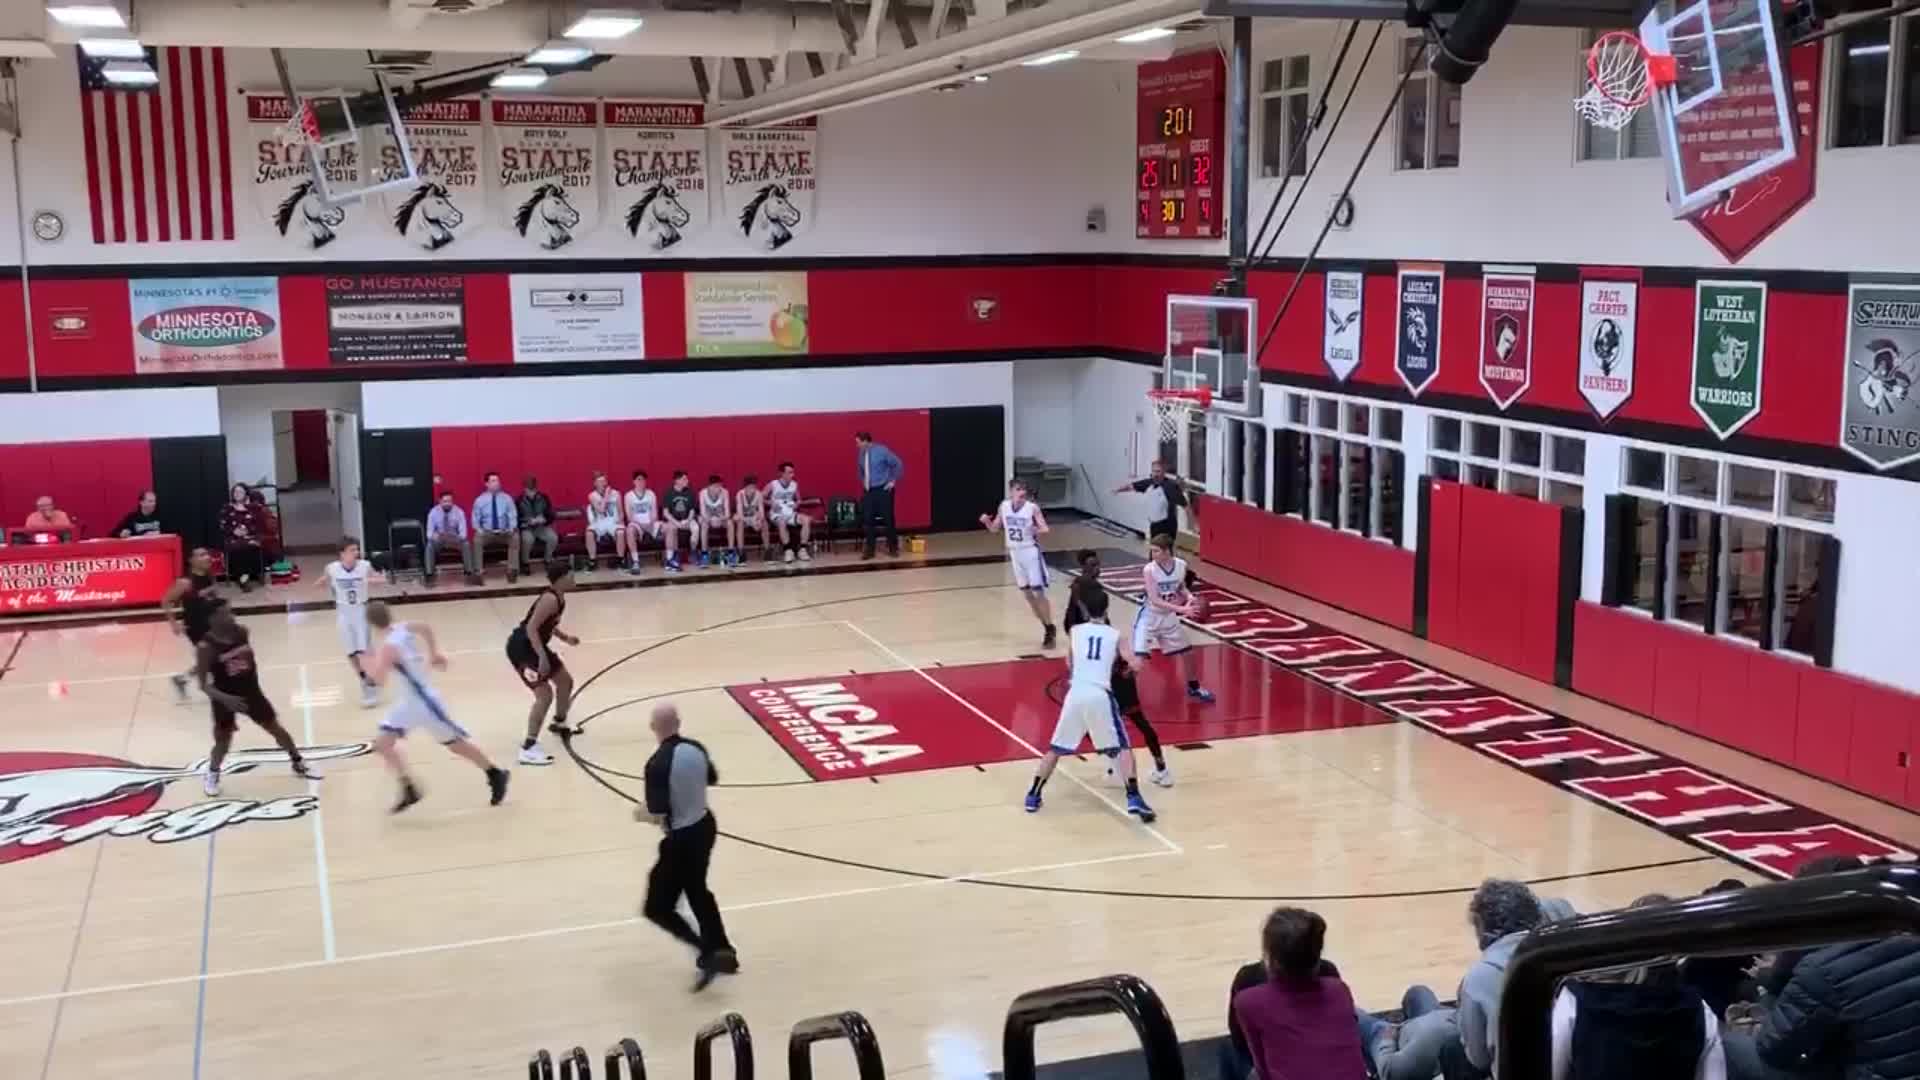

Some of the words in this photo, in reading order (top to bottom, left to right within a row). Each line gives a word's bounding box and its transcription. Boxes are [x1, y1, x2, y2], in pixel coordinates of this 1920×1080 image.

[503, 104, 586, 118] MARANATHA
[614, 106, 696, 121] MARANATHA
[501, 148, 590, 170] STATE
[613, 150, 700, 173] STATE
[727, 151, 812, 173] STATE
[446, 174, 477, 186] 2017
[501, 161, 593, 187] Tournament
[562, 175, 592, 187] 2017
[326, 278, 353, 290] GO
[360, 276, 463, 290] MUSTANGS
[1406, 281, 1434, 292] LEGACY
[1598, 289, 1621, 303] PACT
[1716, 295, 1744, 309] WEST
[1588, 303, 1628, 316] CHARTER
[1703, 308, 1755, 323] LUTHERAN
[155, 311, 258, 329] MINNESOTA
[151, 325, 264, 341] ORTHODONTICS
[1583, 375, 1628, 393] PANTHERS
[1698, 386, 1753, 407] WARRIORS
[1008, 528, 1024, 542] 23
[49, 557, 145, 575] CHRISTIAN
[2, 574, 86, 591] ACADEMY
[8, 593, 22, 608] of
[26, 592, 48, 605] the
[55, 588, 126, 603] Mustangs
[1087, 635, 1104, 661] 11
[750, 689, 856, 771] CONFERENCE
[781, 683, 925, 766] MCAA
